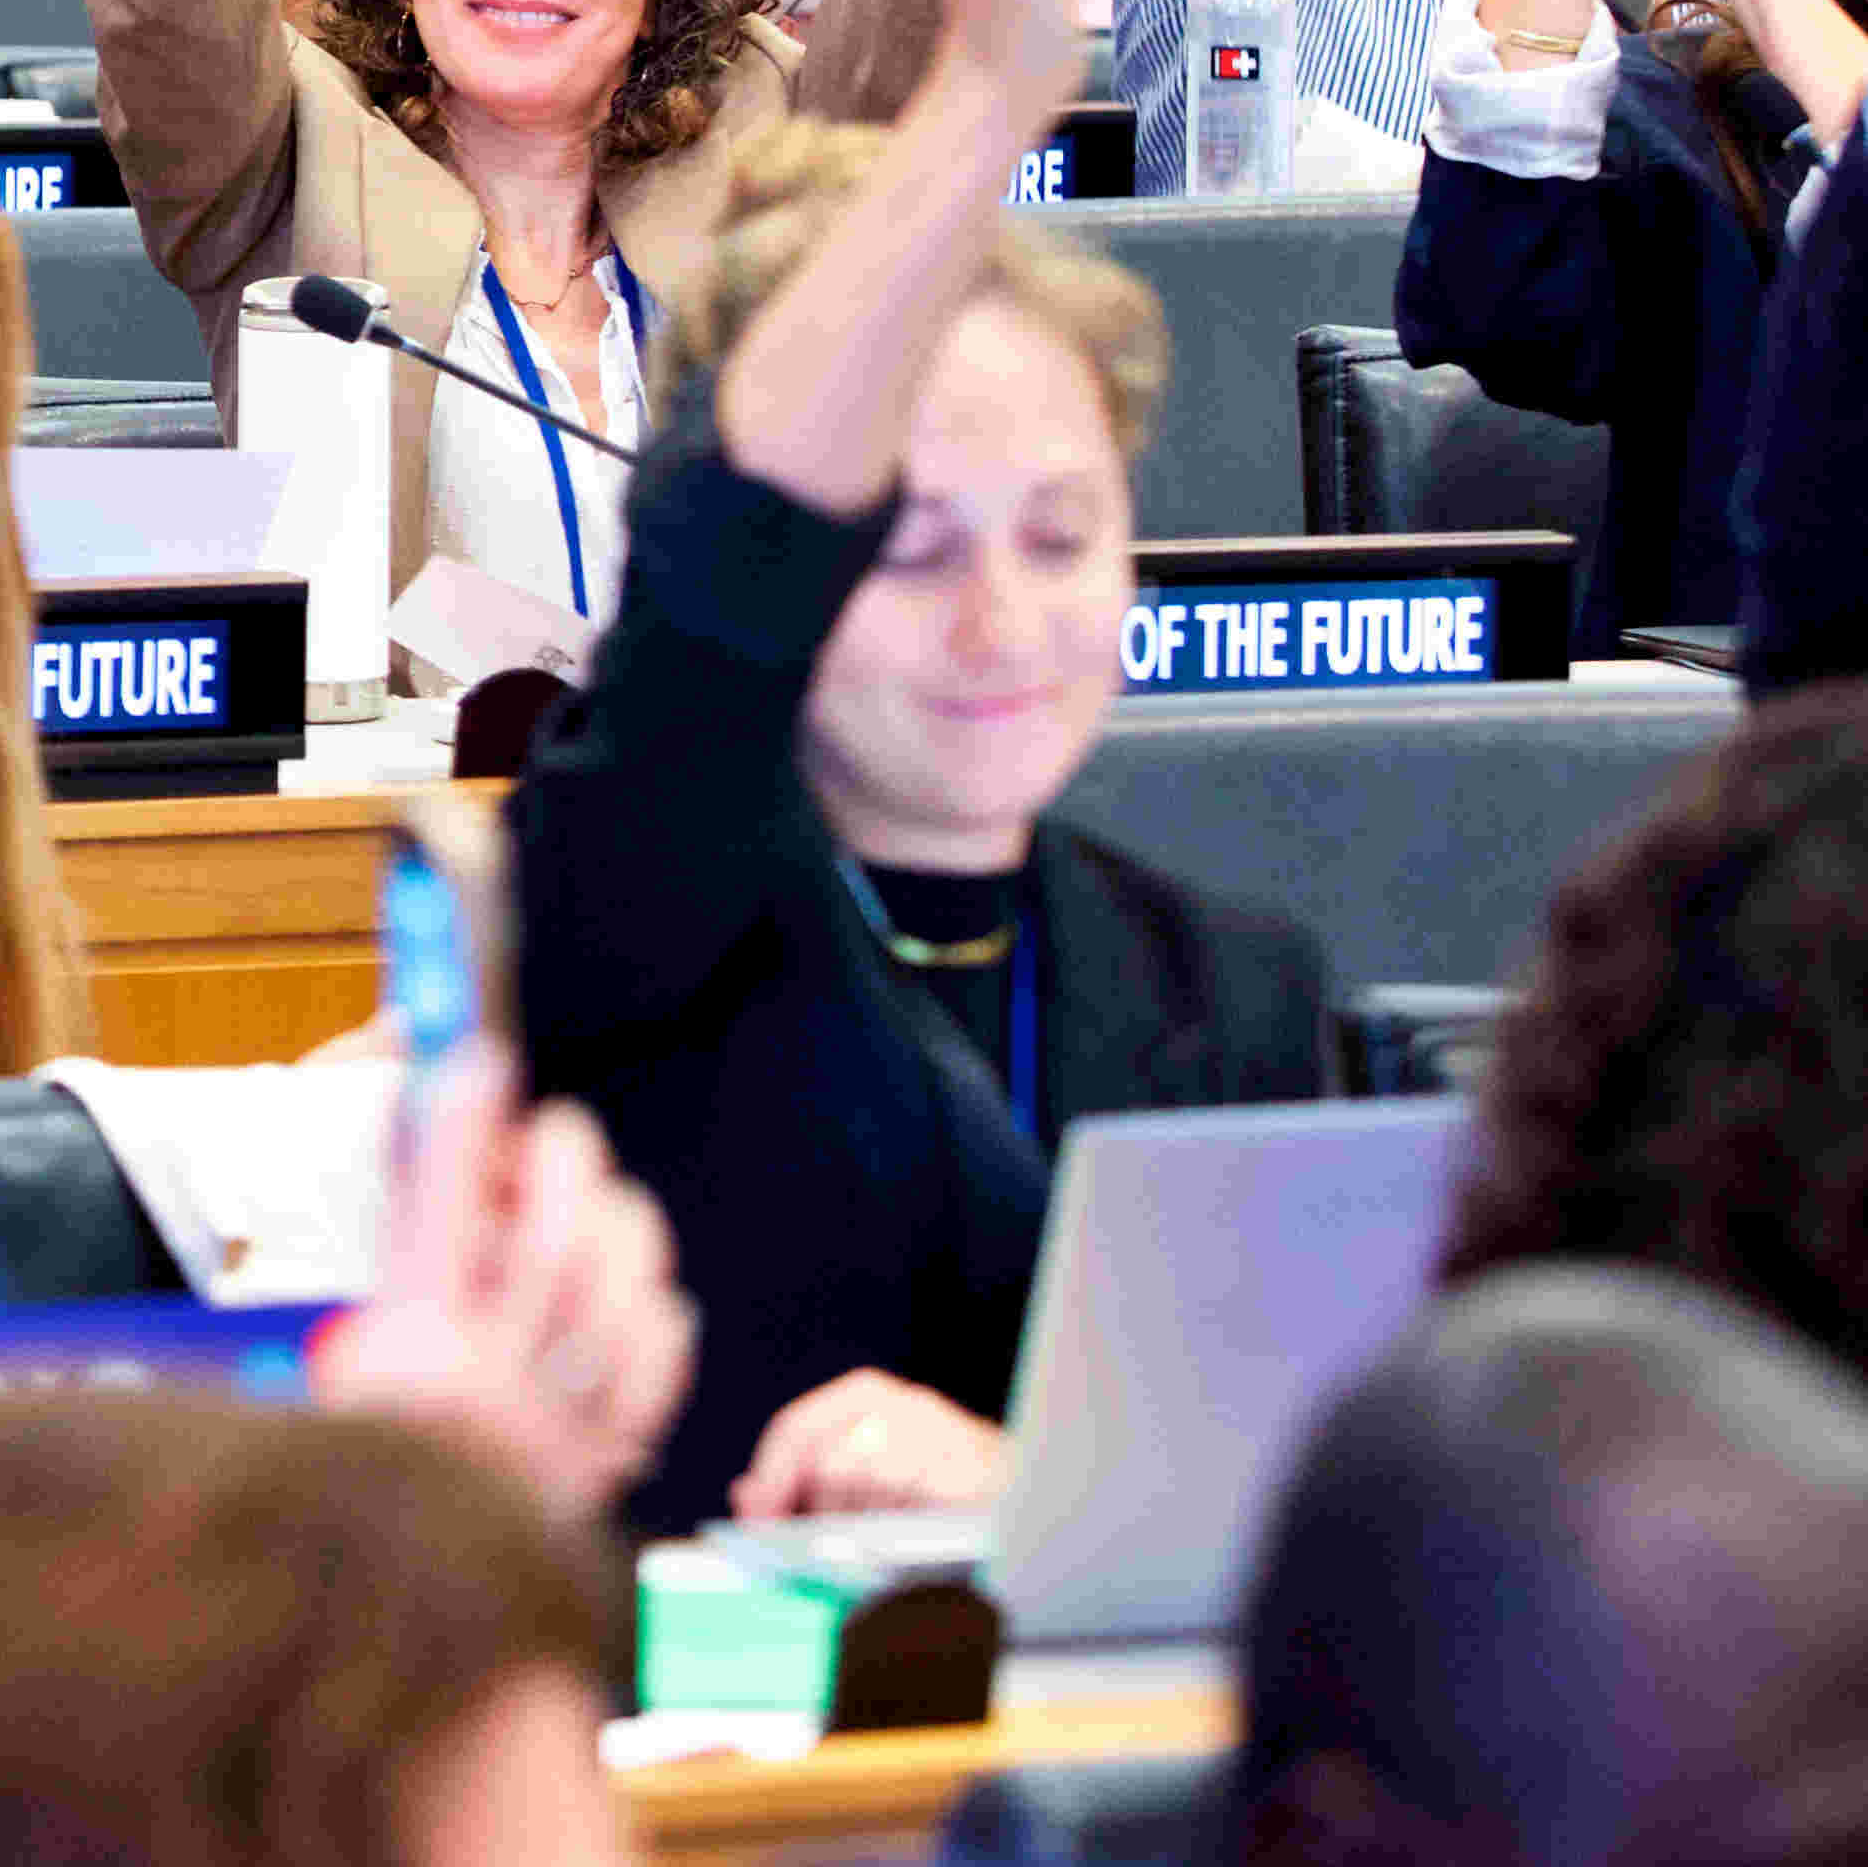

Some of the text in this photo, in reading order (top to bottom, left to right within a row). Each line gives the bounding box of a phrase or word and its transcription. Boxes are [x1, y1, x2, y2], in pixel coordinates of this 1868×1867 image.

[32, 637, 219, 721] FUTURE
[1120, 596, 1486, 681] OF THE FUTURE
